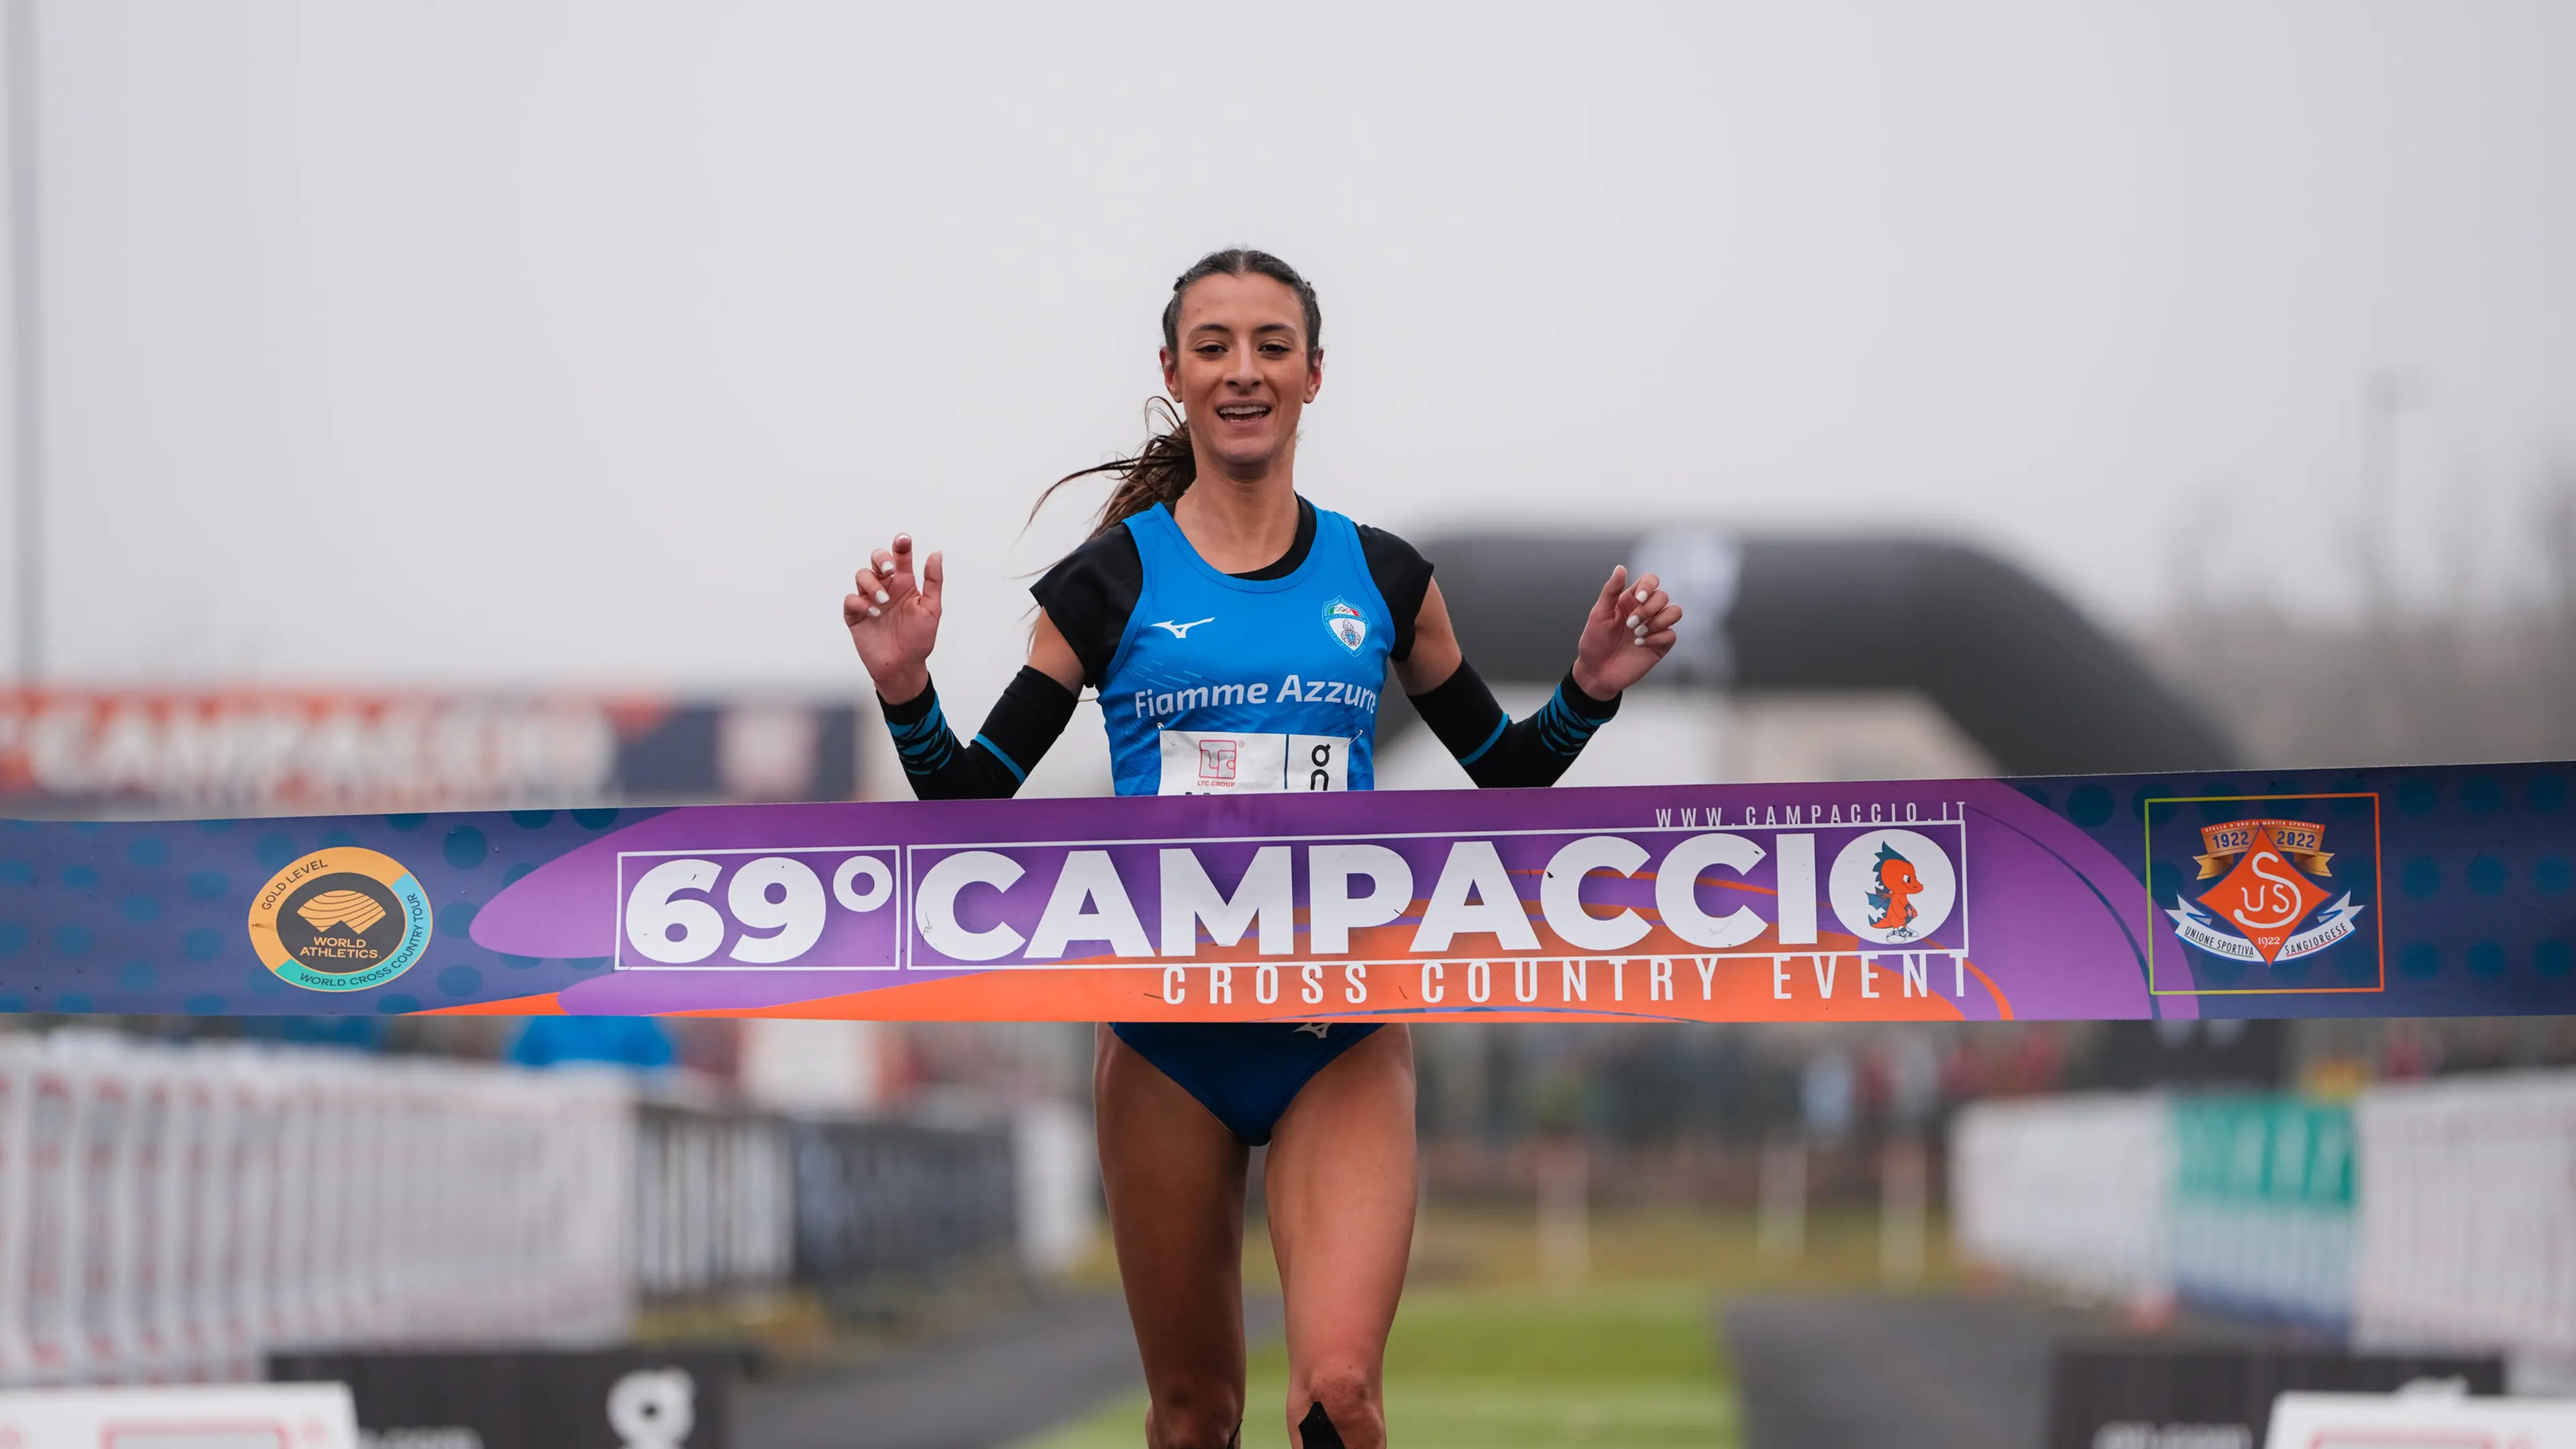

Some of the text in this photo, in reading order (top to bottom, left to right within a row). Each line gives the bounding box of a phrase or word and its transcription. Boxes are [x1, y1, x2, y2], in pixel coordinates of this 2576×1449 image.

[1135, 682, 1269, 718] Fiamme
[1656, 802, 1965, 828] WWW.CAMPACCIO.IT
[2205, 824, 2227, 833] STELLA
[2289, 822, 2320, 830] SPORTIVO
[2212, 830, 2315, 849] 1922 2022
[262, 859, 328, 910] GOLD LEVEL
[915, 829, 1956, 961] CAMPACCIO
[299, 947, 378, 959] ATHLETICS
[300, 892, 424, 987] WORLD CROSS COUNTRY TOUR
[314, 936, 366, 948] WORLD
[2185, 922, 2347, 956] UNIONE SPORTIVA SANGIORGESE
[2258, 936, 2280, 948] 1922
[1163, 953, 1968, 1004] CROSS COUNTRY EVENT
